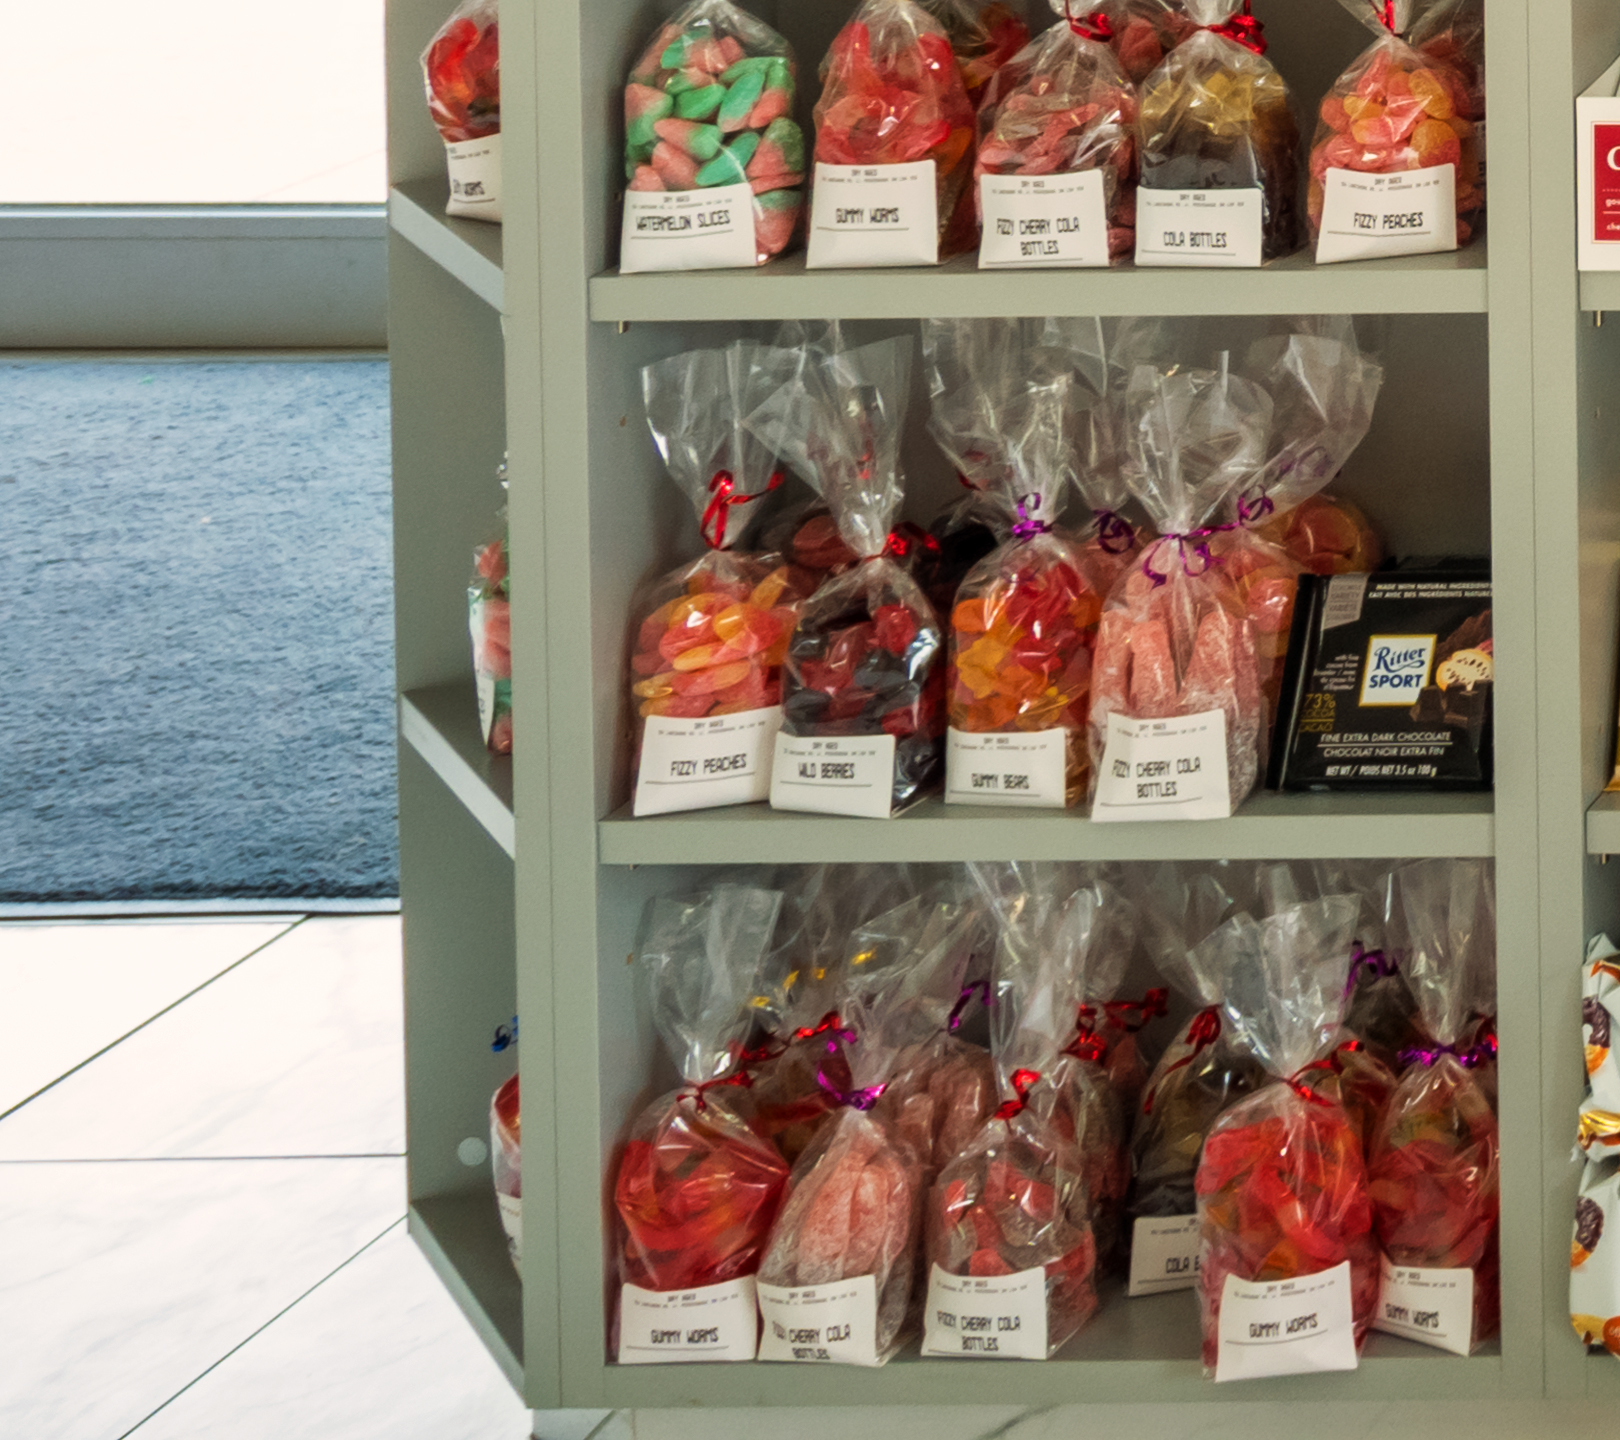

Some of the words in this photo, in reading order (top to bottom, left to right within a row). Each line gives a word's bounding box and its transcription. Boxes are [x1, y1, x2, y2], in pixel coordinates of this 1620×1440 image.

[636, 213, 691, 230] WATERMELON
[697, 210, 730, 226] SLICES
[836, 209, 865, 223] GUMMY
[870, 208, 899, 222] WORMS
[1354, 213, 1377, 229] FIZZY
[1383, 212, 1423, 228] PEACHES
[997, 219, 1016, 235] FIZZY
[1019, 218, 1052, 233] CHERRY
[1056, 217, 1080, 232] COLA
[1021, 241, 1059, 256] BOTTLES
[1164, 232, 1186, 246] COLA
[1190, 233, 1226, 248] BOTTLES
[1373, 646, 1427, 672] Ritter
[1369, 673, 1423, 688] SPORT
[1320, 732, 1340, 741] FINE
[1342, 732, 1370, 741] EXTRA
[1372, 732, 1398, 742] DARK
[1400, 732, 1451, 742] CHOCOLATE
[671, 760, 697, 776] FIZZY
[703, 754, 747, 773] PEACHES
[799, 763, 816, 779] WILD
[819, 762, 855, 779] BERRIES
[972, 774, 999, 789] GUMMY
[1004, 774, 1029, 789] BEARS
[651, 1329, 681, 1344] GUMMY
[687, 1327, 718, 1343] WORMS
